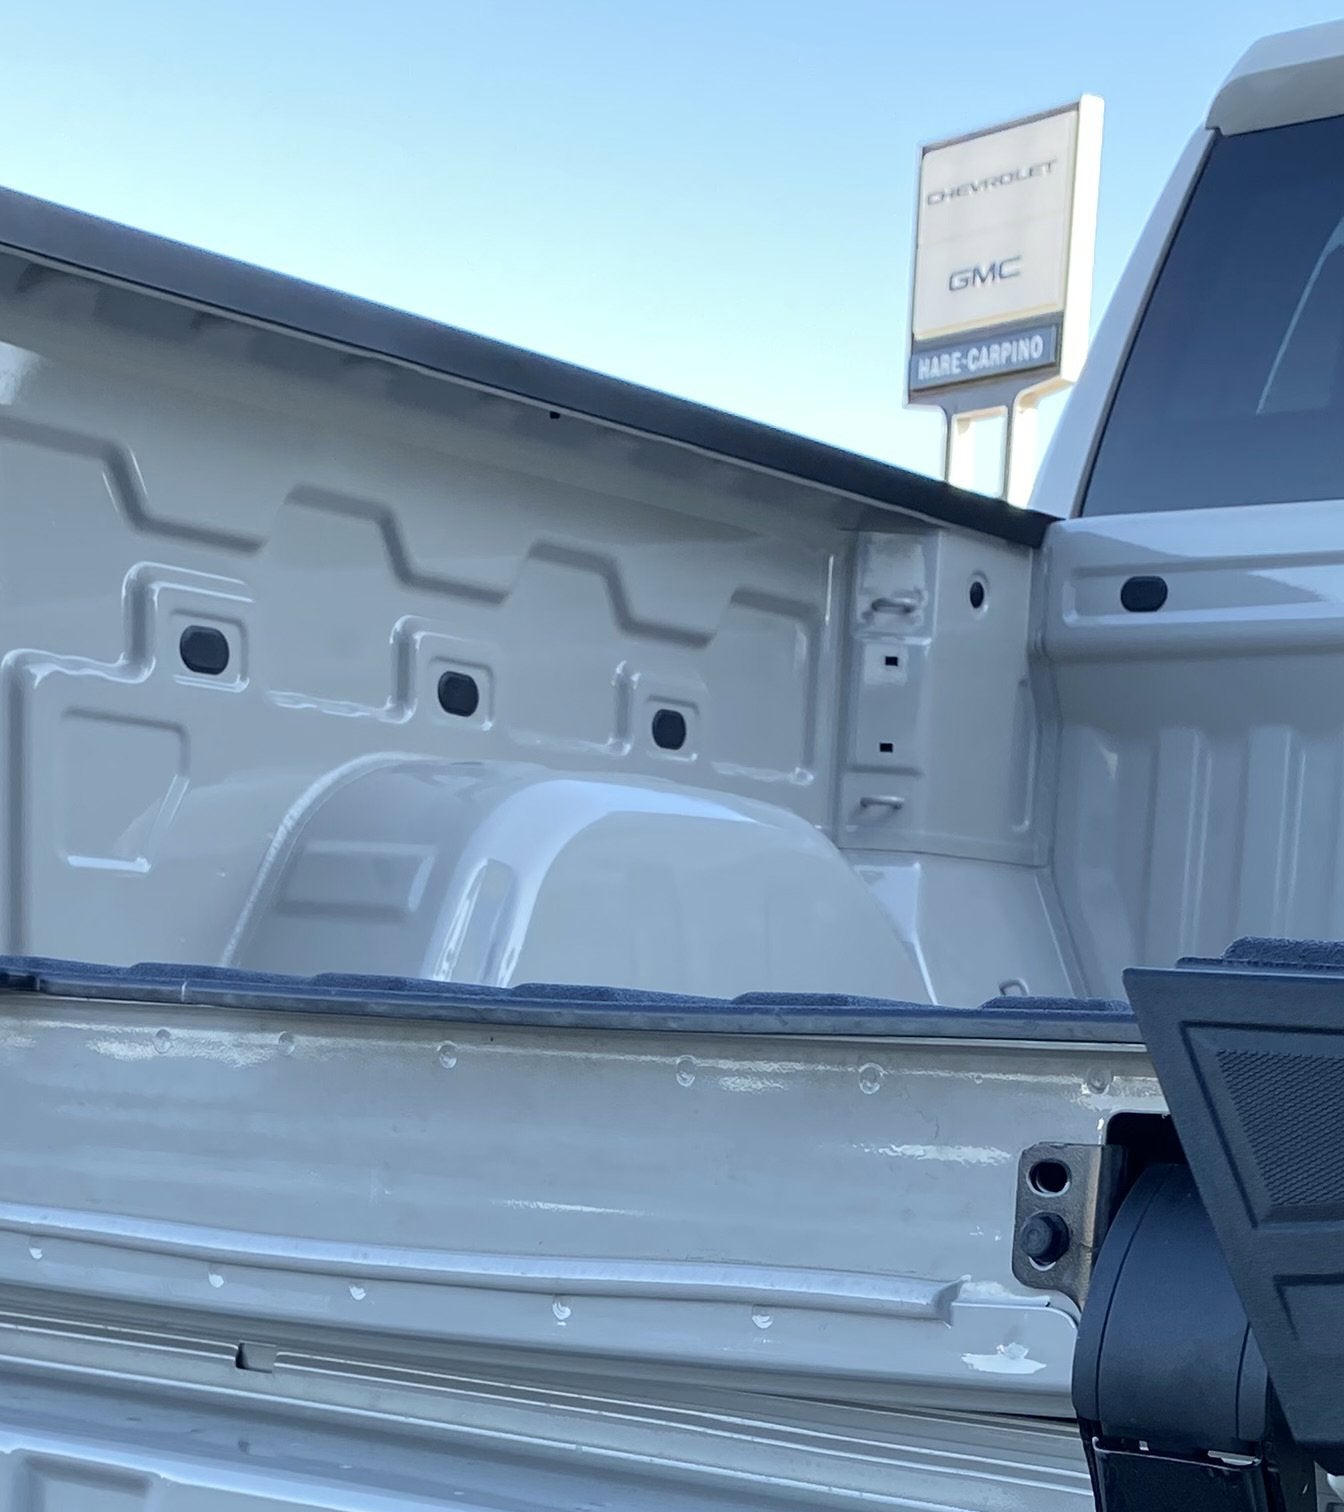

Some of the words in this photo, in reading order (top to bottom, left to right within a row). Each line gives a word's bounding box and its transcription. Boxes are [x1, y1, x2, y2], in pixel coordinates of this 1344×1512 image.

[927, 159, 1057, 206] CHEVROLET
[949, 255, 1023, 291] GMC
[917, 334, 1044, 380] HARE-CARPINO
